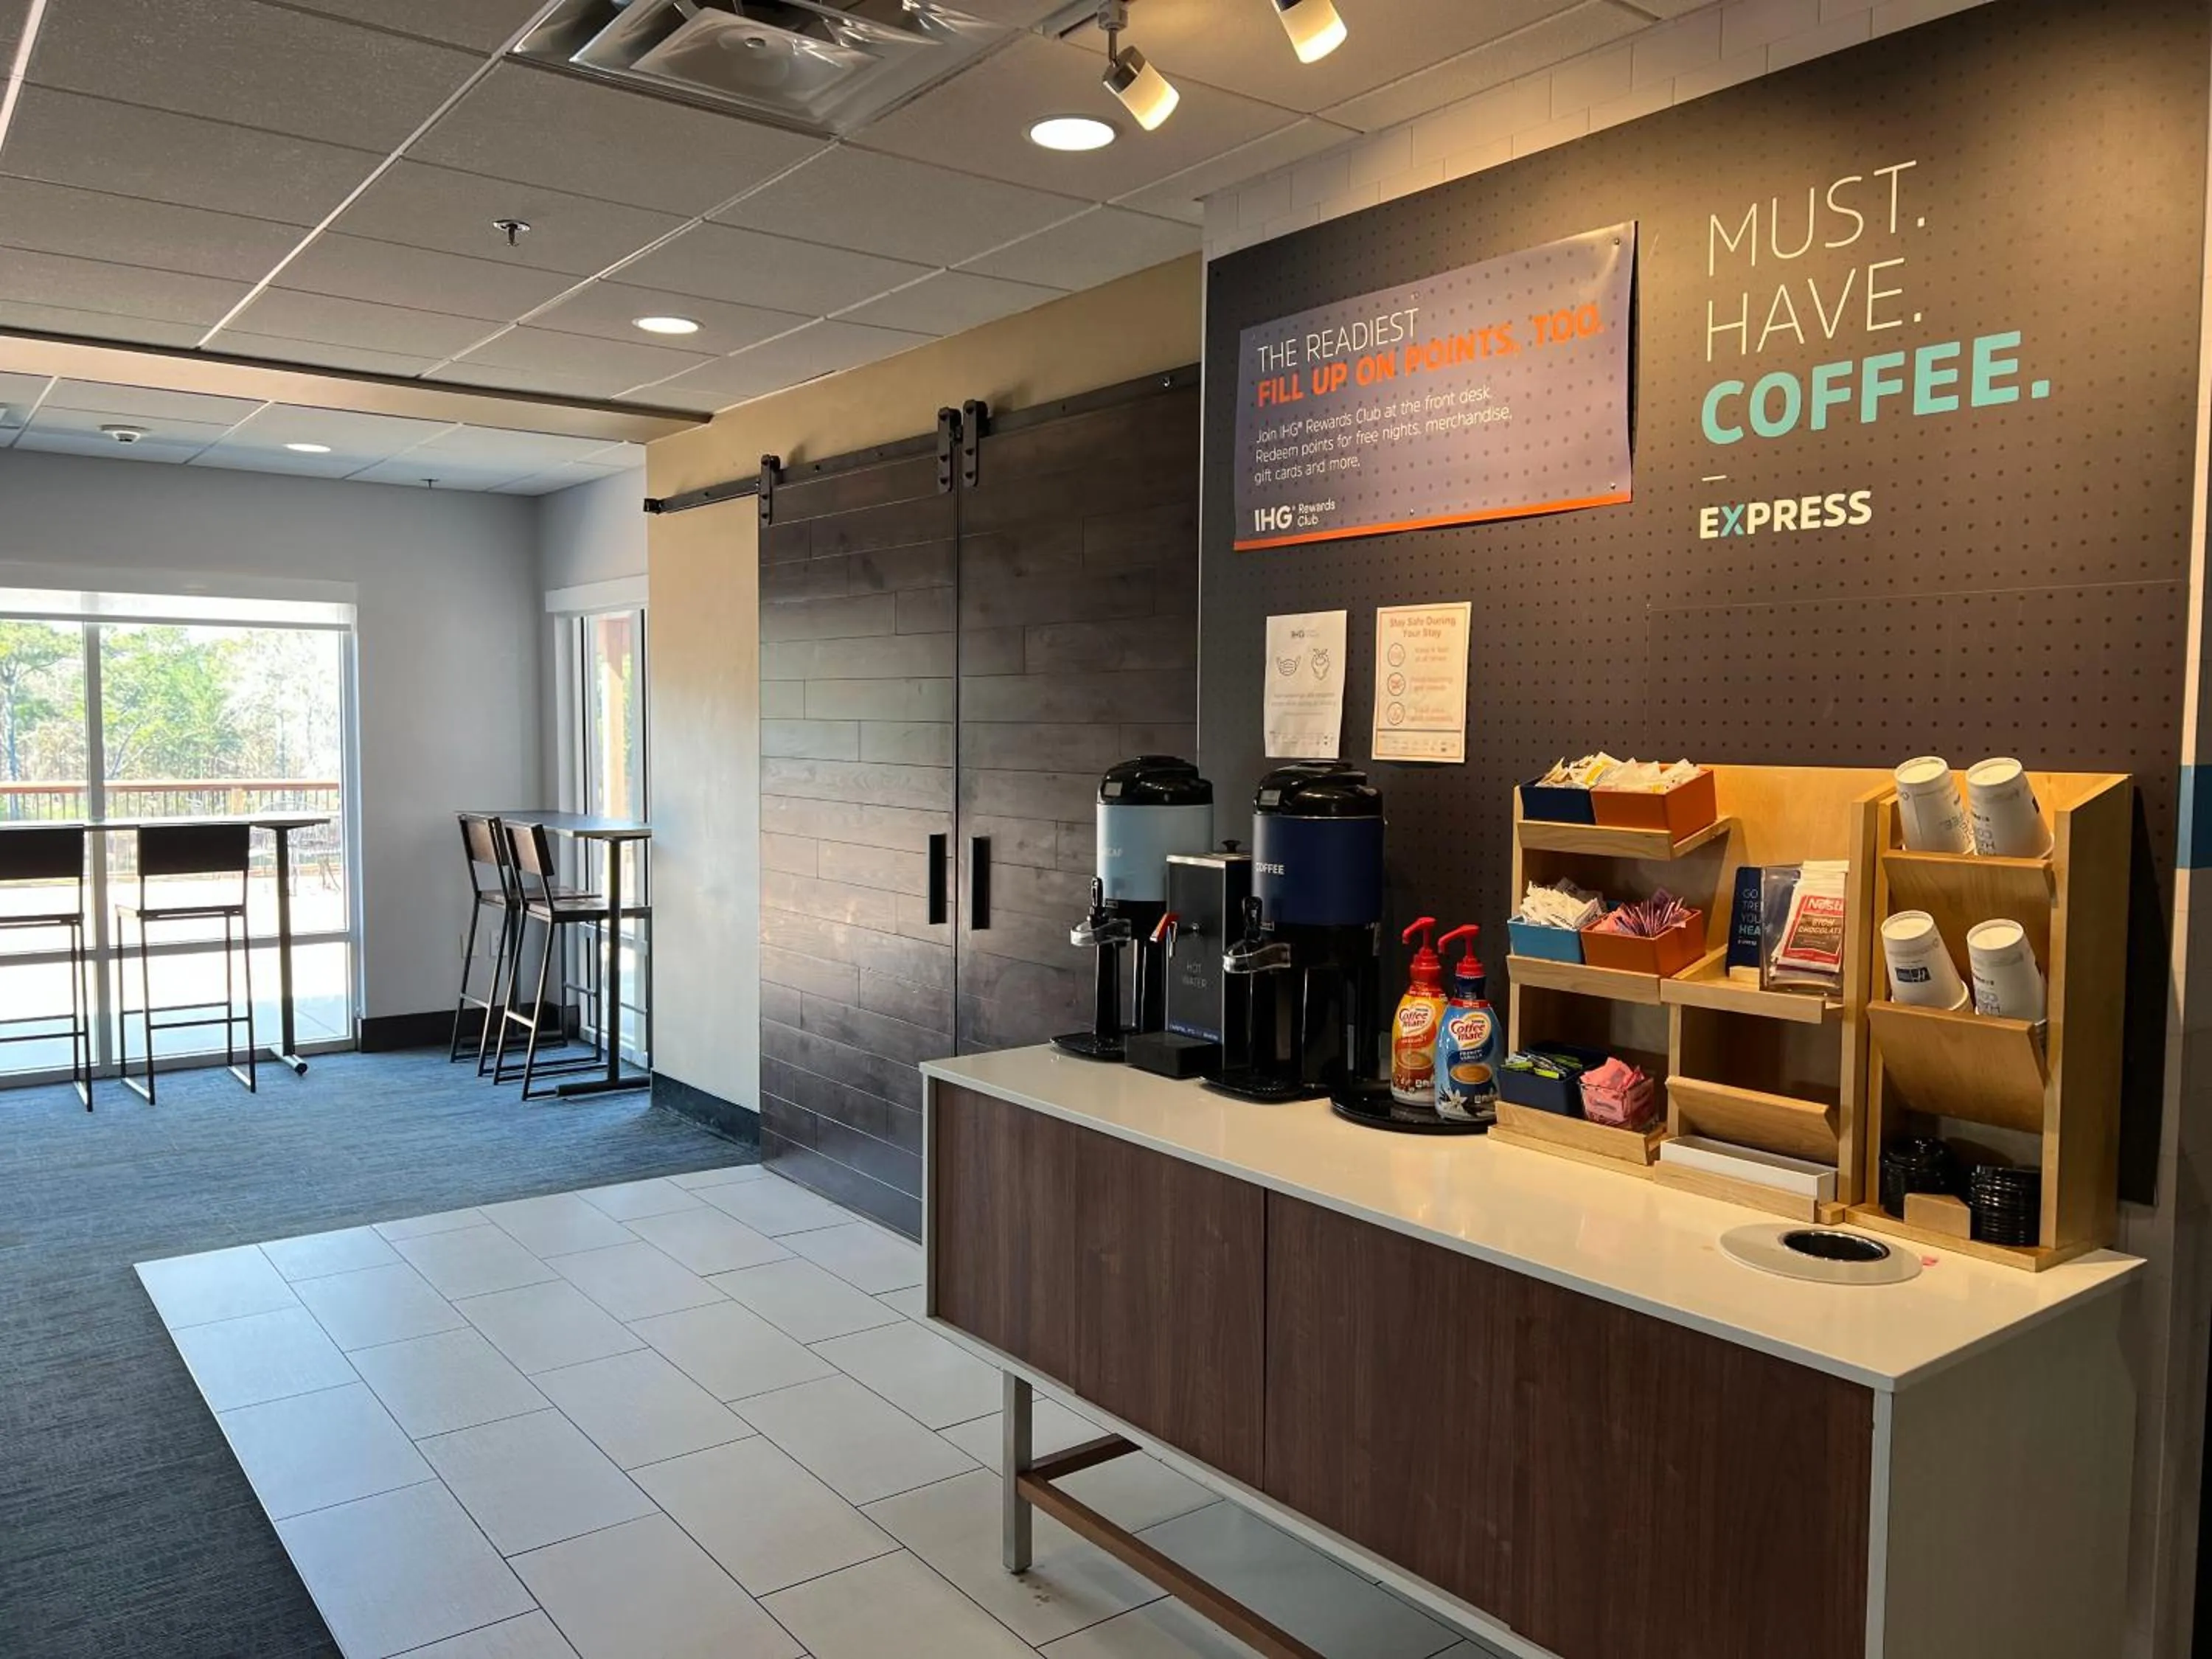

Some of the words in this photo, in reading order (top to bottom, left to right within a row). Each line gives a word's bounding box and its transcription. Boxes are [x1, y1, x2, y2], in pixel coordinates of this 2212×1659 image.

[1708, 159, 1925, 276] MUST.
[1706, 257, 1921, 362] HAVE.
[1257, 338, 1298, 372] THE
[1306, 307, 1419, 363] READIEST
[1257, 373, 1305, 407] FILL
[1312, 362, 1348, 395] UP
[1356, 349, 1396, 386] ON
[1532, 303, 1604, 349] TOO.
[1701, 330, 2051, 445] COFFEE.
[1256, 428, 1277, 444] Join
[1306, 412, 1352, 434] Rewards
[1356, 406, 1381, 424] Club
[1384, 402, 1397, 418] at
[1401, 400, 1421, 414] the
[1424, 392, 1455, 411] front
[1256, 446, 1298, 463] Redeem
[1301, 438, 1334, 456] points
[1337, 434, 1352, 448] for
[1356, 430, 1379, 445] free
[1254, 470, 1272, 486] gift
[1275, 464, 1303, 481] cards
[1306, 460, 1325, 476] and
[1297, 514, 1319, 527] Club
[1298, 498, 1335, 514] Rewards
[1699, 490, 1873, 540] EXPRESS
[1255, 862, 1285, 875] COFFEE
[1450, 1020, 1486, 1034] Coffee
